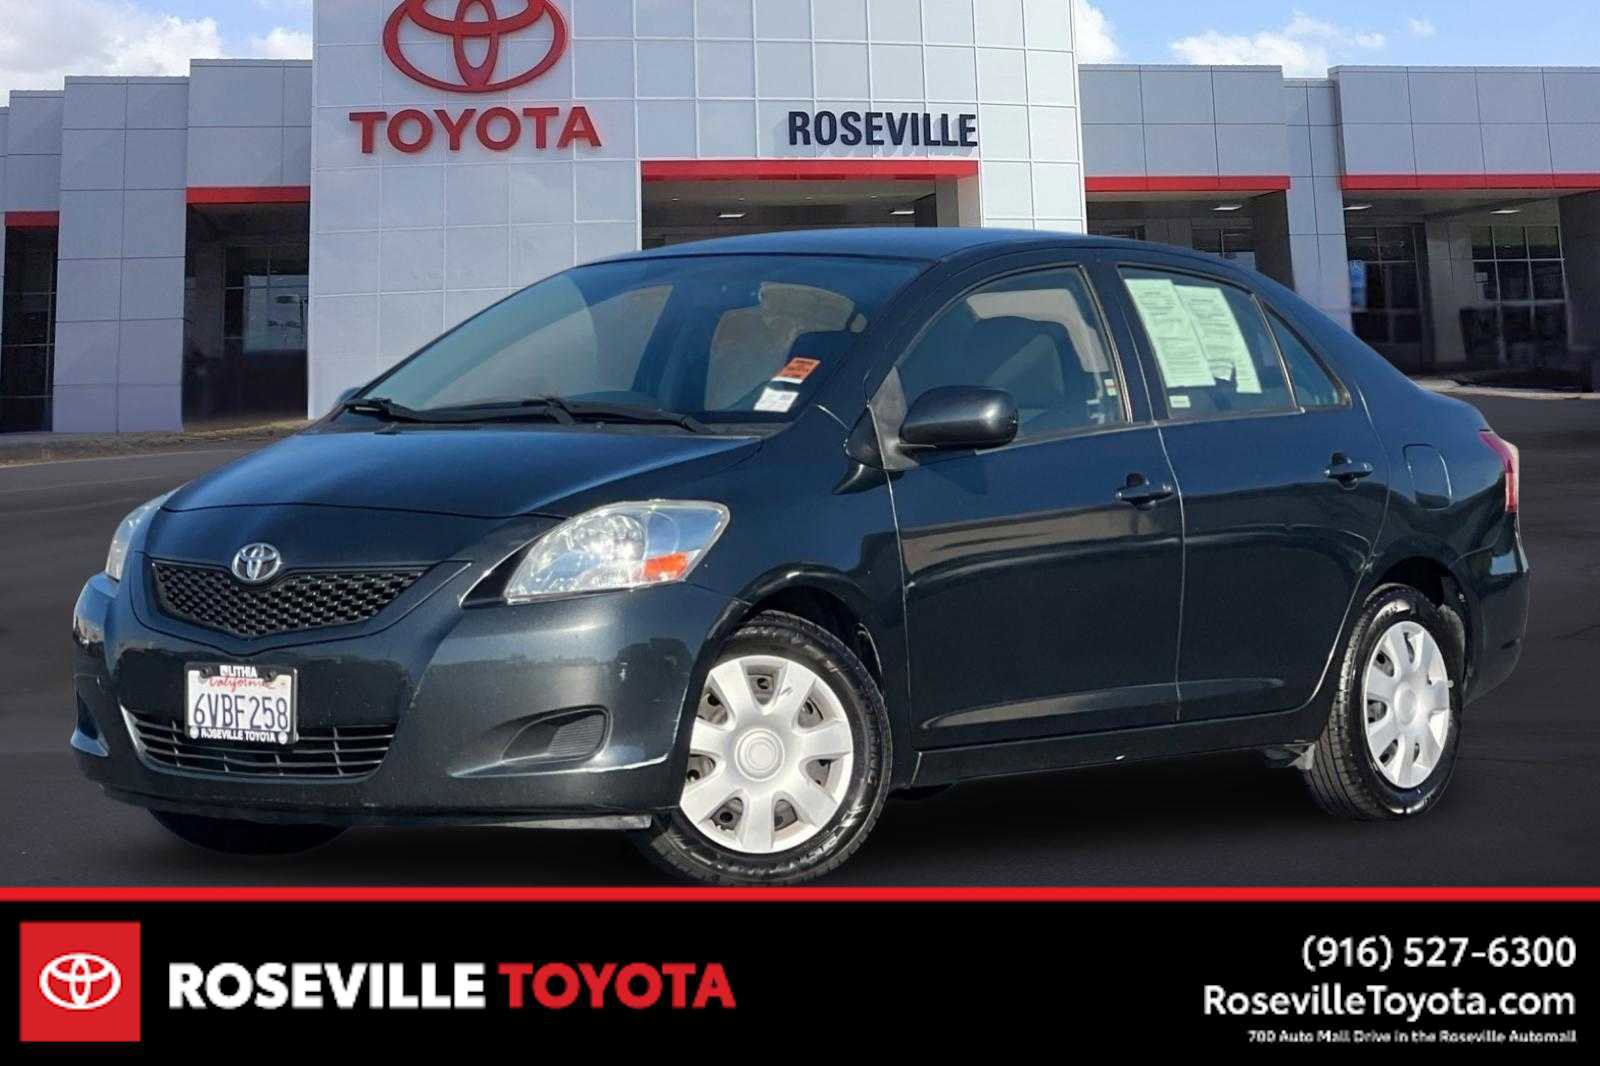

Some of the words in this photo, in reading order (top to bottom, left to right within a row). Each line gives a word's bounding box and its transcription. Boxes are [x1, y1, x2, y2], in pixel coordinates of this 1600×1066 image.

[349, 106, 602, 153] TOYOTA
[789, 111, 978, 147] ROSEVILLE
[230, 665, 258, 678] LITHIA
[194, 694, 287, 729] 6VBF258
[201, 728, 243, 740] ROSEVILLE
[246, 731, 276, 742] TOYOTA
